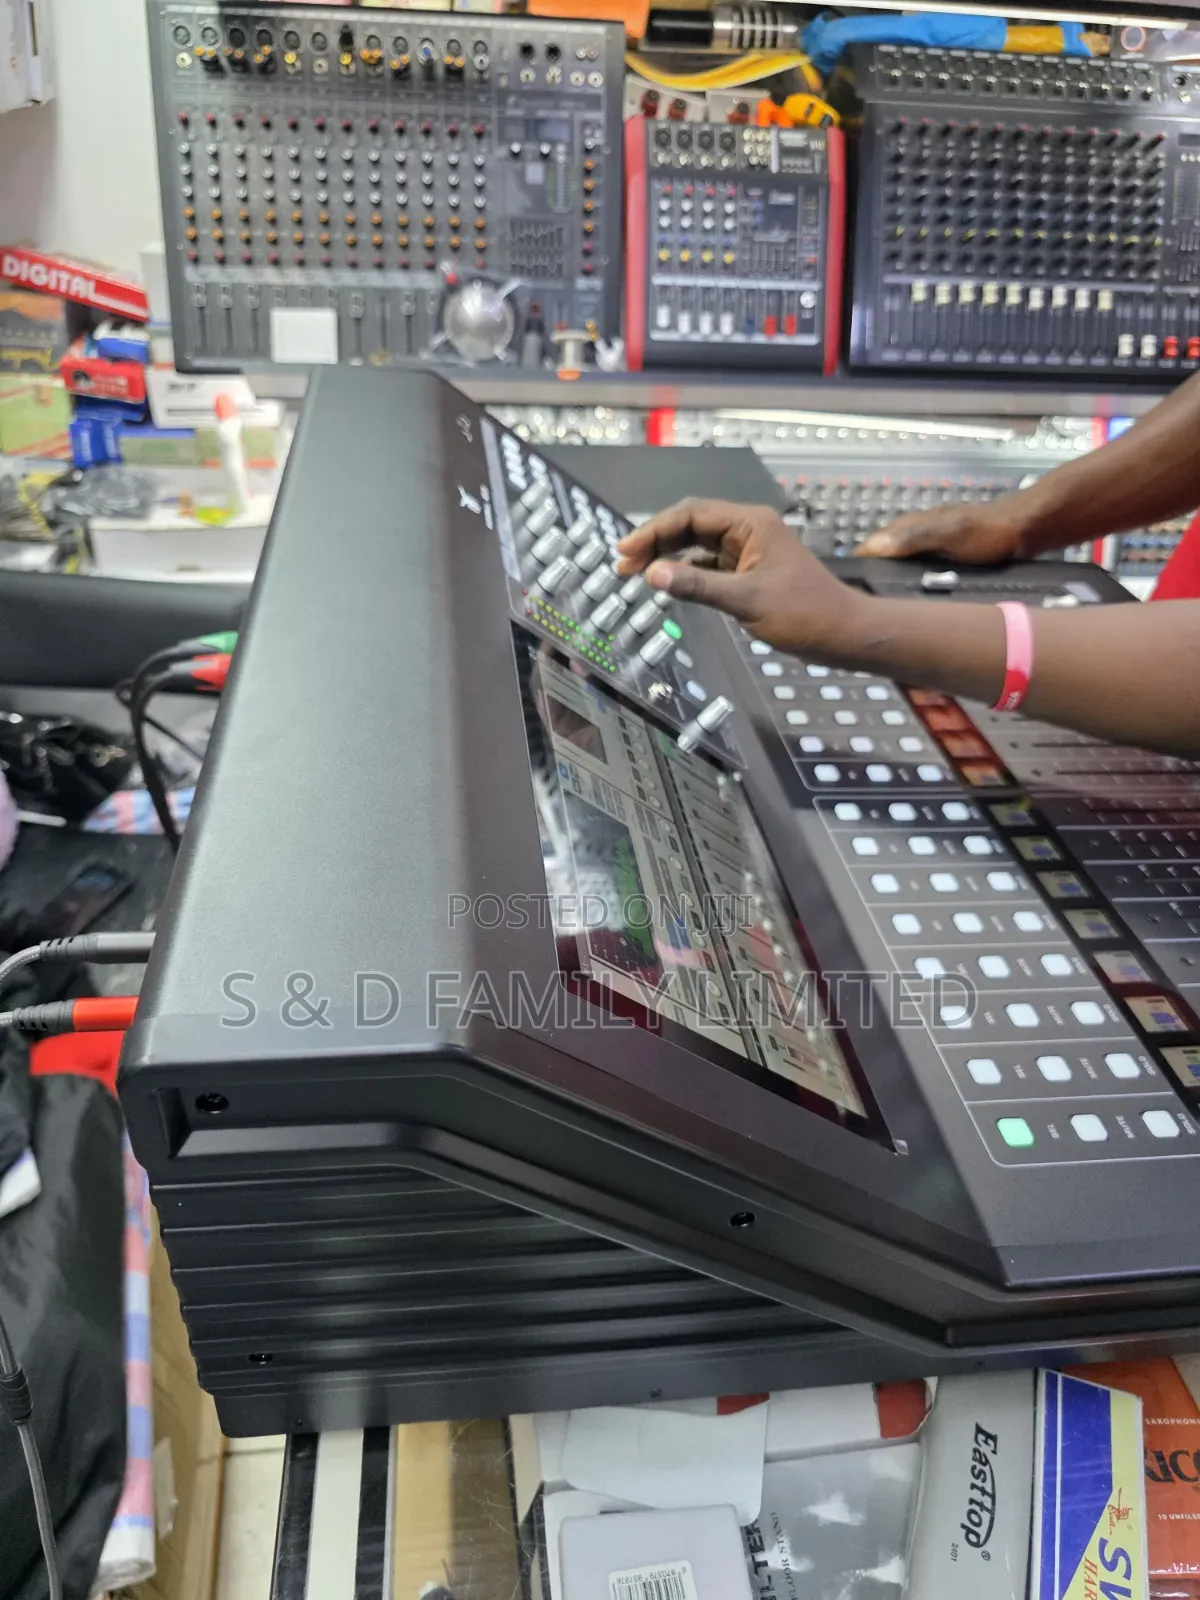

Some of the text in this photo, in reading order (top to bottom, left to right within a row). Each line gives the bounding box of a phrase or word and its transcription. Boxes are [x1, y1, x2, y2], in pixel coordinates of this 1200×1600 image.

[4, 257, 98, 299] DIGITAL
[1144, 1445, 1200, 1483] IC
[959, 1421, 999, 1549] Easttop
[1158, 1513, 1167, 1521] 10
